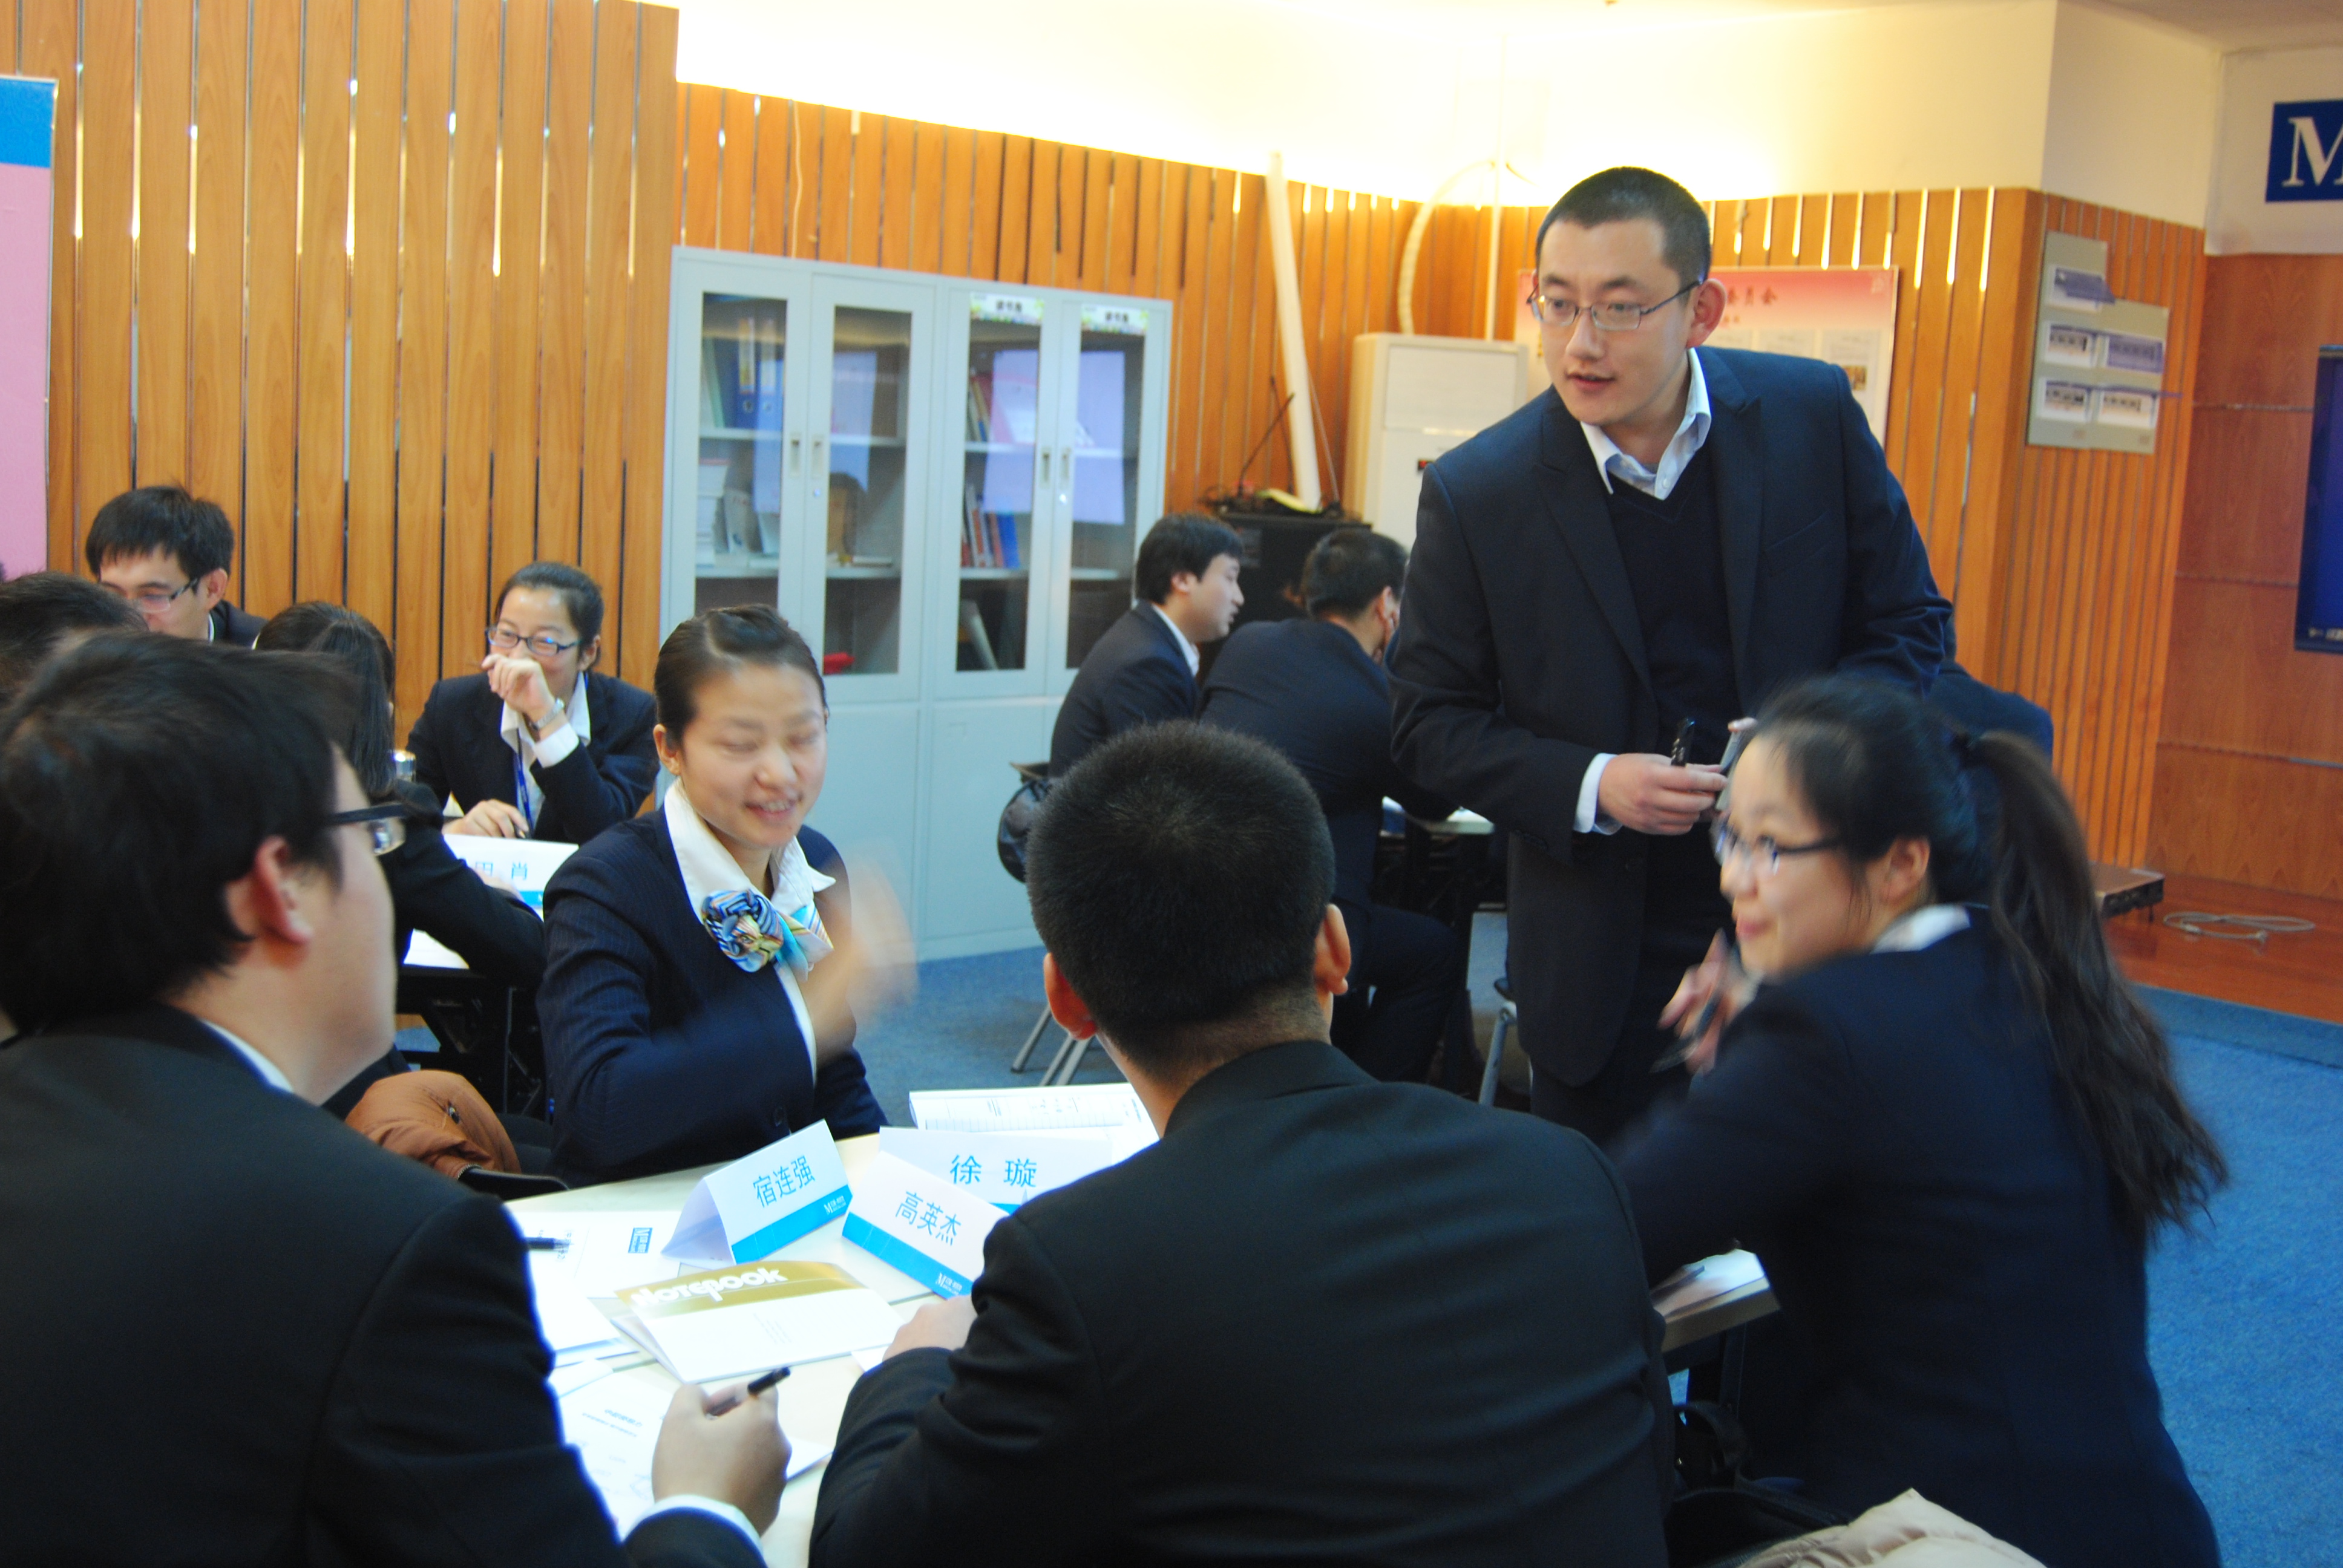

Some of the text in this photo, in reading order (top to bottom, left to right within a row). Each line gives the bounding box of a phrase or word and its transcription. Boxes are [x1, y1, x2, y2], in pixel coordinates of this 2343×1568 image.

[2281, 116, 2343, 188] M
[752, 1154, 816, 1208] 宿连强
[949, 1154, 1037, 1187] 徐璇
[895, 1191, 962, 1246] 高英杰
